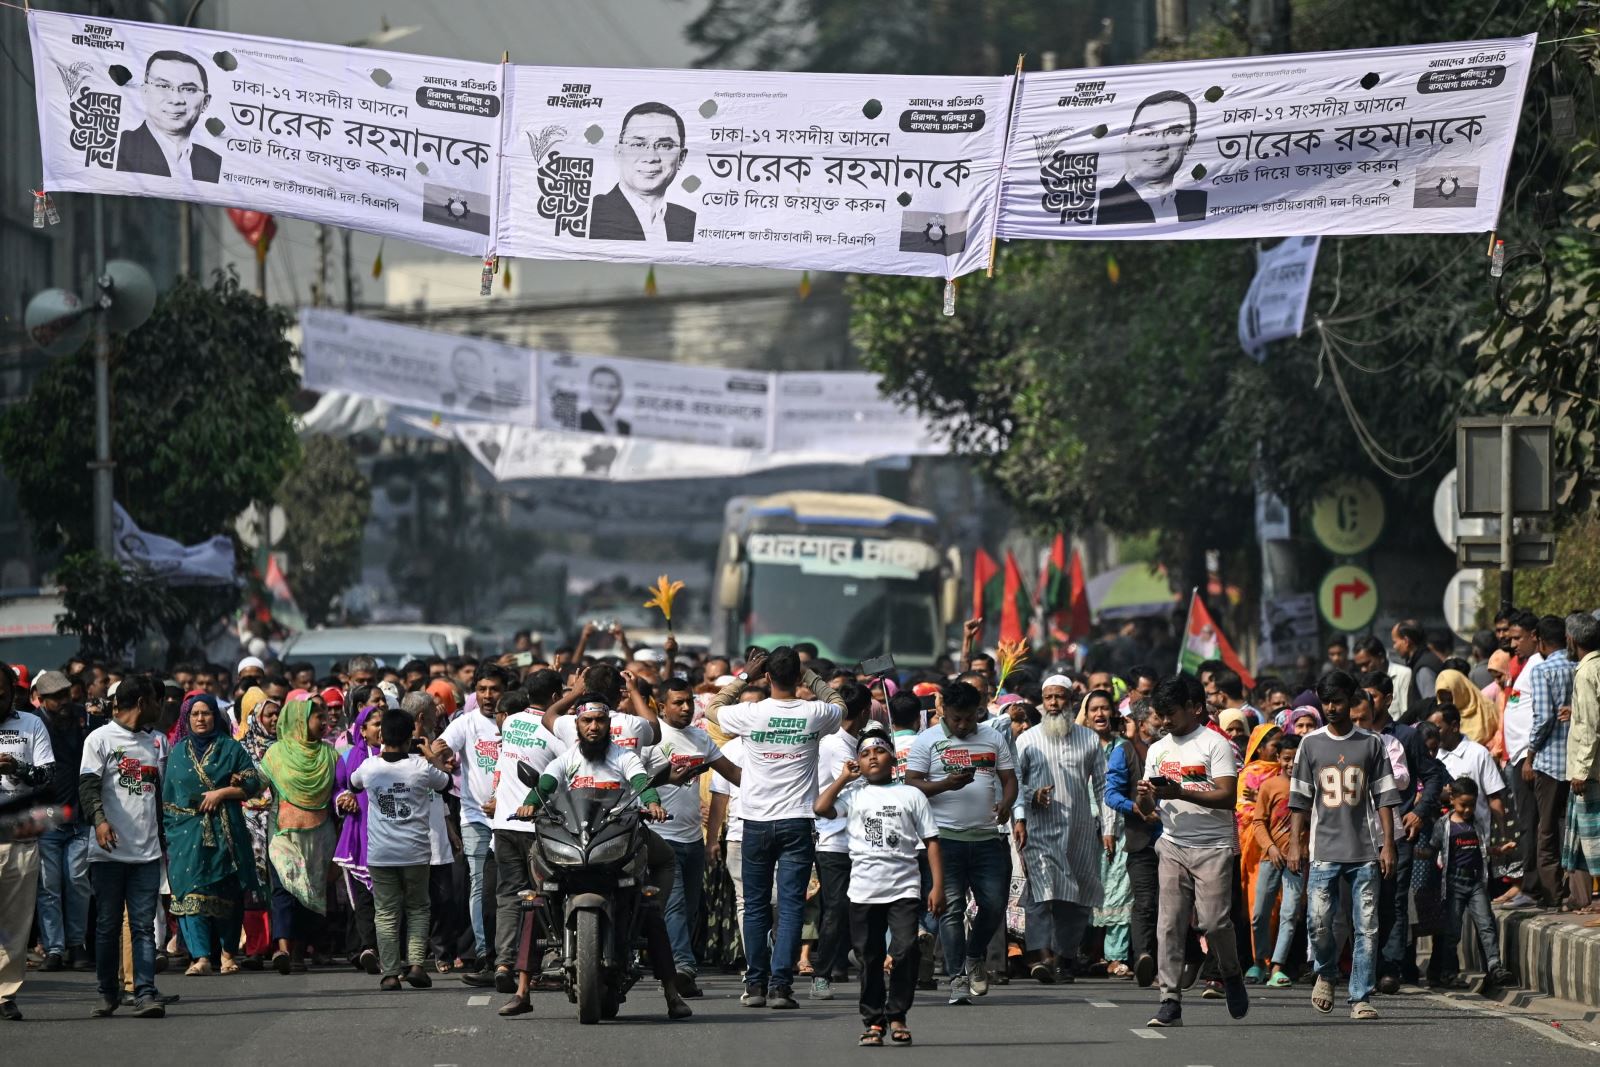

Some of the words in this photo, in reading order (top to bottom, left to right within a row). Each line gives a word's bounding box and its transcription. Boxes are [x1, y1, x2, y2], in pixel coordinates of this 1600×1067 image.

[84, 24, 112, 37] সবার
[72, 35, 125, 50] বাংলাদেশ
[1428, 57, 1465, 68] আমাদের
[1467, 51, 1506, 65] প্রতিশ্রুতি
[423, 76, 457, 87] আমাদের
[461, 78, 497, 92] প্রতিশ্রুতি
[561, 83, 591, 94] সবার
[1075, 81, 1106, 93] সবার
[1461, 78, 1492, 87] ঢাকা-১৭
[70, 87, 122, 114] ধানের
[232, 79, 290, 101] ঢাকা-১৭
[296, 89, 352, 110] সংসদীয়
[358, 99, 408, 118] আসনে
[459, 103, 489, 114] ঢাকা-১৭
[547, 96, 603, 109] বাংলাদেশ
[908, 98, 943, 108] আমাদের
[947, 95, 984, 107] প্রতিশ্রুতি
[1058, 93, 1116, 107] বাংলাদেশ
[1223, 106, 1283, 123] ঢাকা-১৭
[1290, 98, 1348, 119] সংসদীয়
[1354, 97, 1406, 114] আসনে
[230, 102, 334, 141] তারেক
[343, 120, 491, 170] রহমানকে
[711, 127, 770, 144] ঢাকা-১৭
[776, 125, 833, 146] সংসদীয়
[839, 131, 890, 147] আসনে
[942, 122, 973, 130] ঢাকা-১৭
[1216, 129, 1324, 160] তারেক
[1335, 115, 1486, 152] রহমানকে
[85, 146, 117, 169] দিন
[227, 137, 261, 154] ভোট
[268, 140, 300, 161] দিয়ে
[306, 150, 360, 173] জয়যুক্ত
[366, 161, 406, 181] করুন
[538, 151, 593, 178] ধানের
[1041, 150, 1099, 175] ধানের
[706, 151, 813, 183] তারেক
[823, 154, 972, 189] রহমানকে
[1213, 169, 1249, 186] ভোট
[1255, 165, 1289, 181] দিয়ে
[1295, 161, 1352, 179] জয়যুক্ত
[1358, 159, 1399, 173] করুন
[223, 172, 270, 190] বাংলাদেশ
[273, 180, 337, 201] জাতীয়তাবাদী
[340, 192, 399, 212] দল-বিএনপি
[702, 190, 738, 207] ভোট
[744, 190, 778, 209] দিয়ে
[784, 195, 839, 215] জয়যুক্ত
[845, 197, 885, 213] করুন
[1210, 203, 1258, 216] বাংলাদেশ
[1261, 195, 1326, 212] জাতীয়তাবাদী
[1330, 193, 1391, 208] দল-বিএনপি
[555, 213, 587, 238] দিন
[1060, 207, 1094, 224] দিন
[698, 228, 745, 241] বাংলাদেশ
[749, 229, 813, 244] জাতীয়তাবাদী
[816, 232, 876, 247] দল-বিএনপি
[510, 719, 538, 733] সবার
[768, 717, 807, 730] সবার
[502, 730, 547, 750] াংলাদেশ
[751, 730, 818, 745] বাংলাদেশ
[1319, 763, 1366, 808] 99
